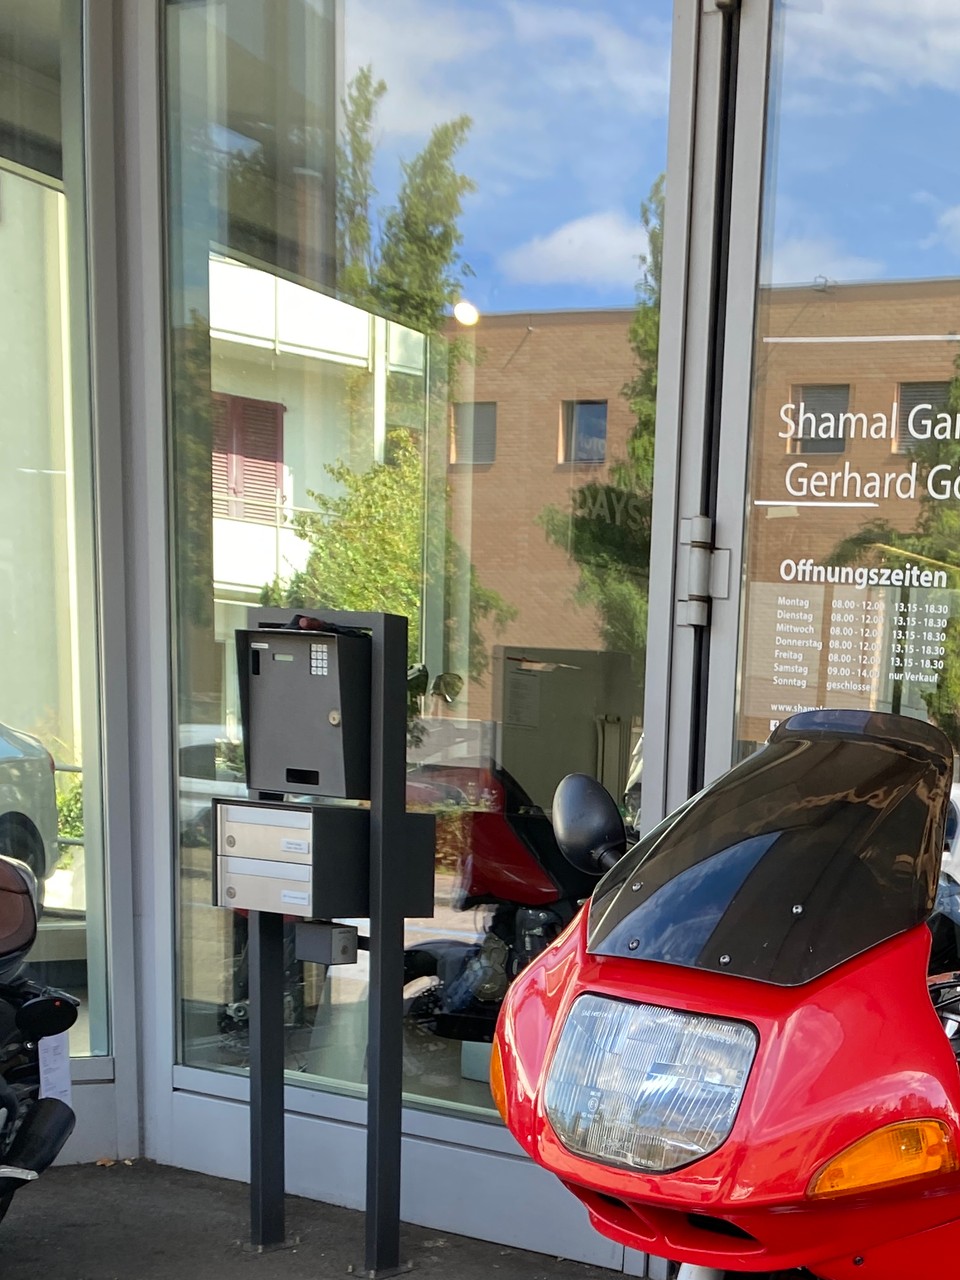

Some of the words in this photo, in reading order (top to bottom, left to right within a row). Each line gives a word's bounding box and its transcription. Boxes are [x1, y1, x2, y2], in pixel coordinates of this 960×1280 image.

[777, 402, 897, 440] Shamal
[785, 461, 917, 499] Gerhard
[778, 596, 810, 609] Montag
[832, 600, 856, 609] 08.00
[894, 602, 918, 612] 13.15
[924, 604, 949, 614] 18.30
[777, 609, 813, 622] Dienstag
[831, 613, 855, 622] 08.00
[893, 616, 916, 626] 13.15
[923, 618, 947, 628] 18.30
[776, 623, 815, 634] Mittwoch
[830, 627, 853, 636] 08.00
[892, 630, 916, 640] 13.15
[922, 631, 946, 641] 18.30
[775, 636, 823, 651] Donnerstag
[829, 640, 853, 650] 08.00
[891, 643, 914, 654] 13.15
[921, 645, 945, 656] 18.30
[774, 649, 803, 662] Freitag
[828, 653, 852, 663] 08.00
[890, 657, 913, 667] 13.15
[920, 659, 944, 669] 18.30
[772, 675, 807, 689] Sonntag
[773, 662, 808, 675] Samstag
[827, 666, 851, 676] 09.00
[889, 672, 904, 680] nur
[905, 672, 939, 683] Verkauf
